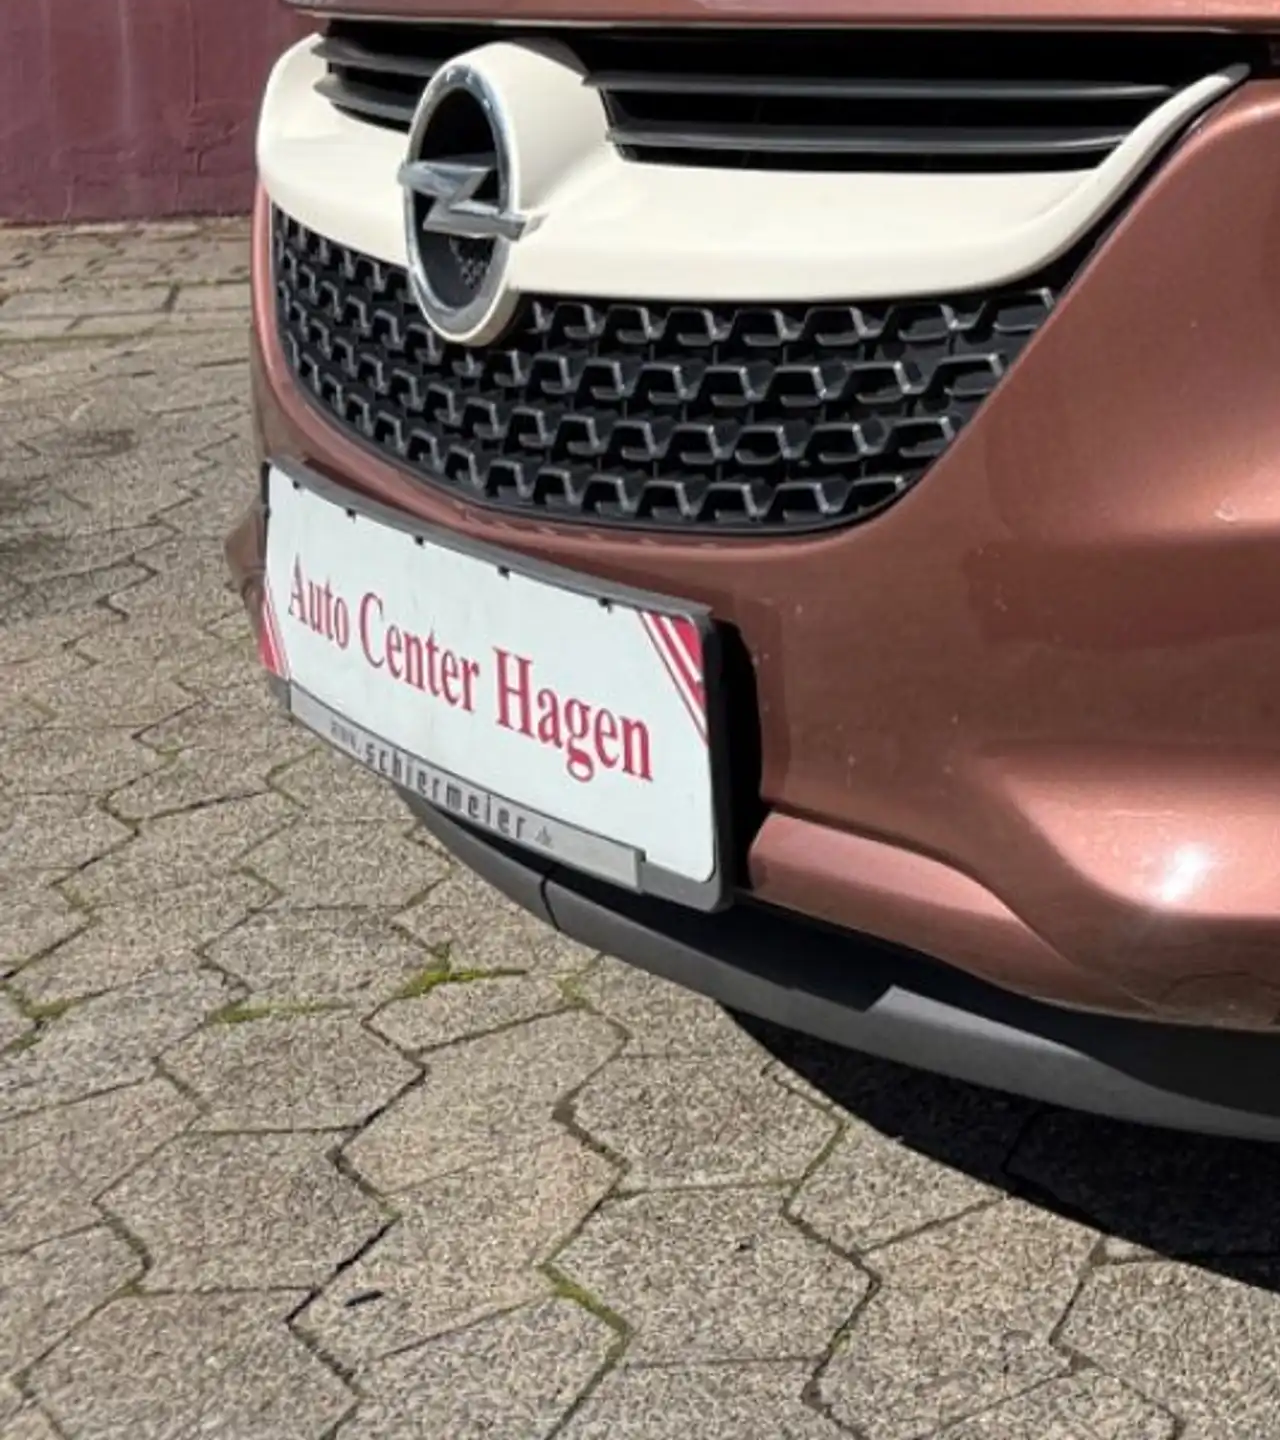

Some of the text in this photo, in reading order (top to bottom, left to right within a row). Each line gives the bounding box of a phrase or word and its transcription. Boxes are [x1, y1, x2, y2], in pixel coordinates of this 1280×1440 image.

[287, 552, 654, 782] Auto Center Hagen
